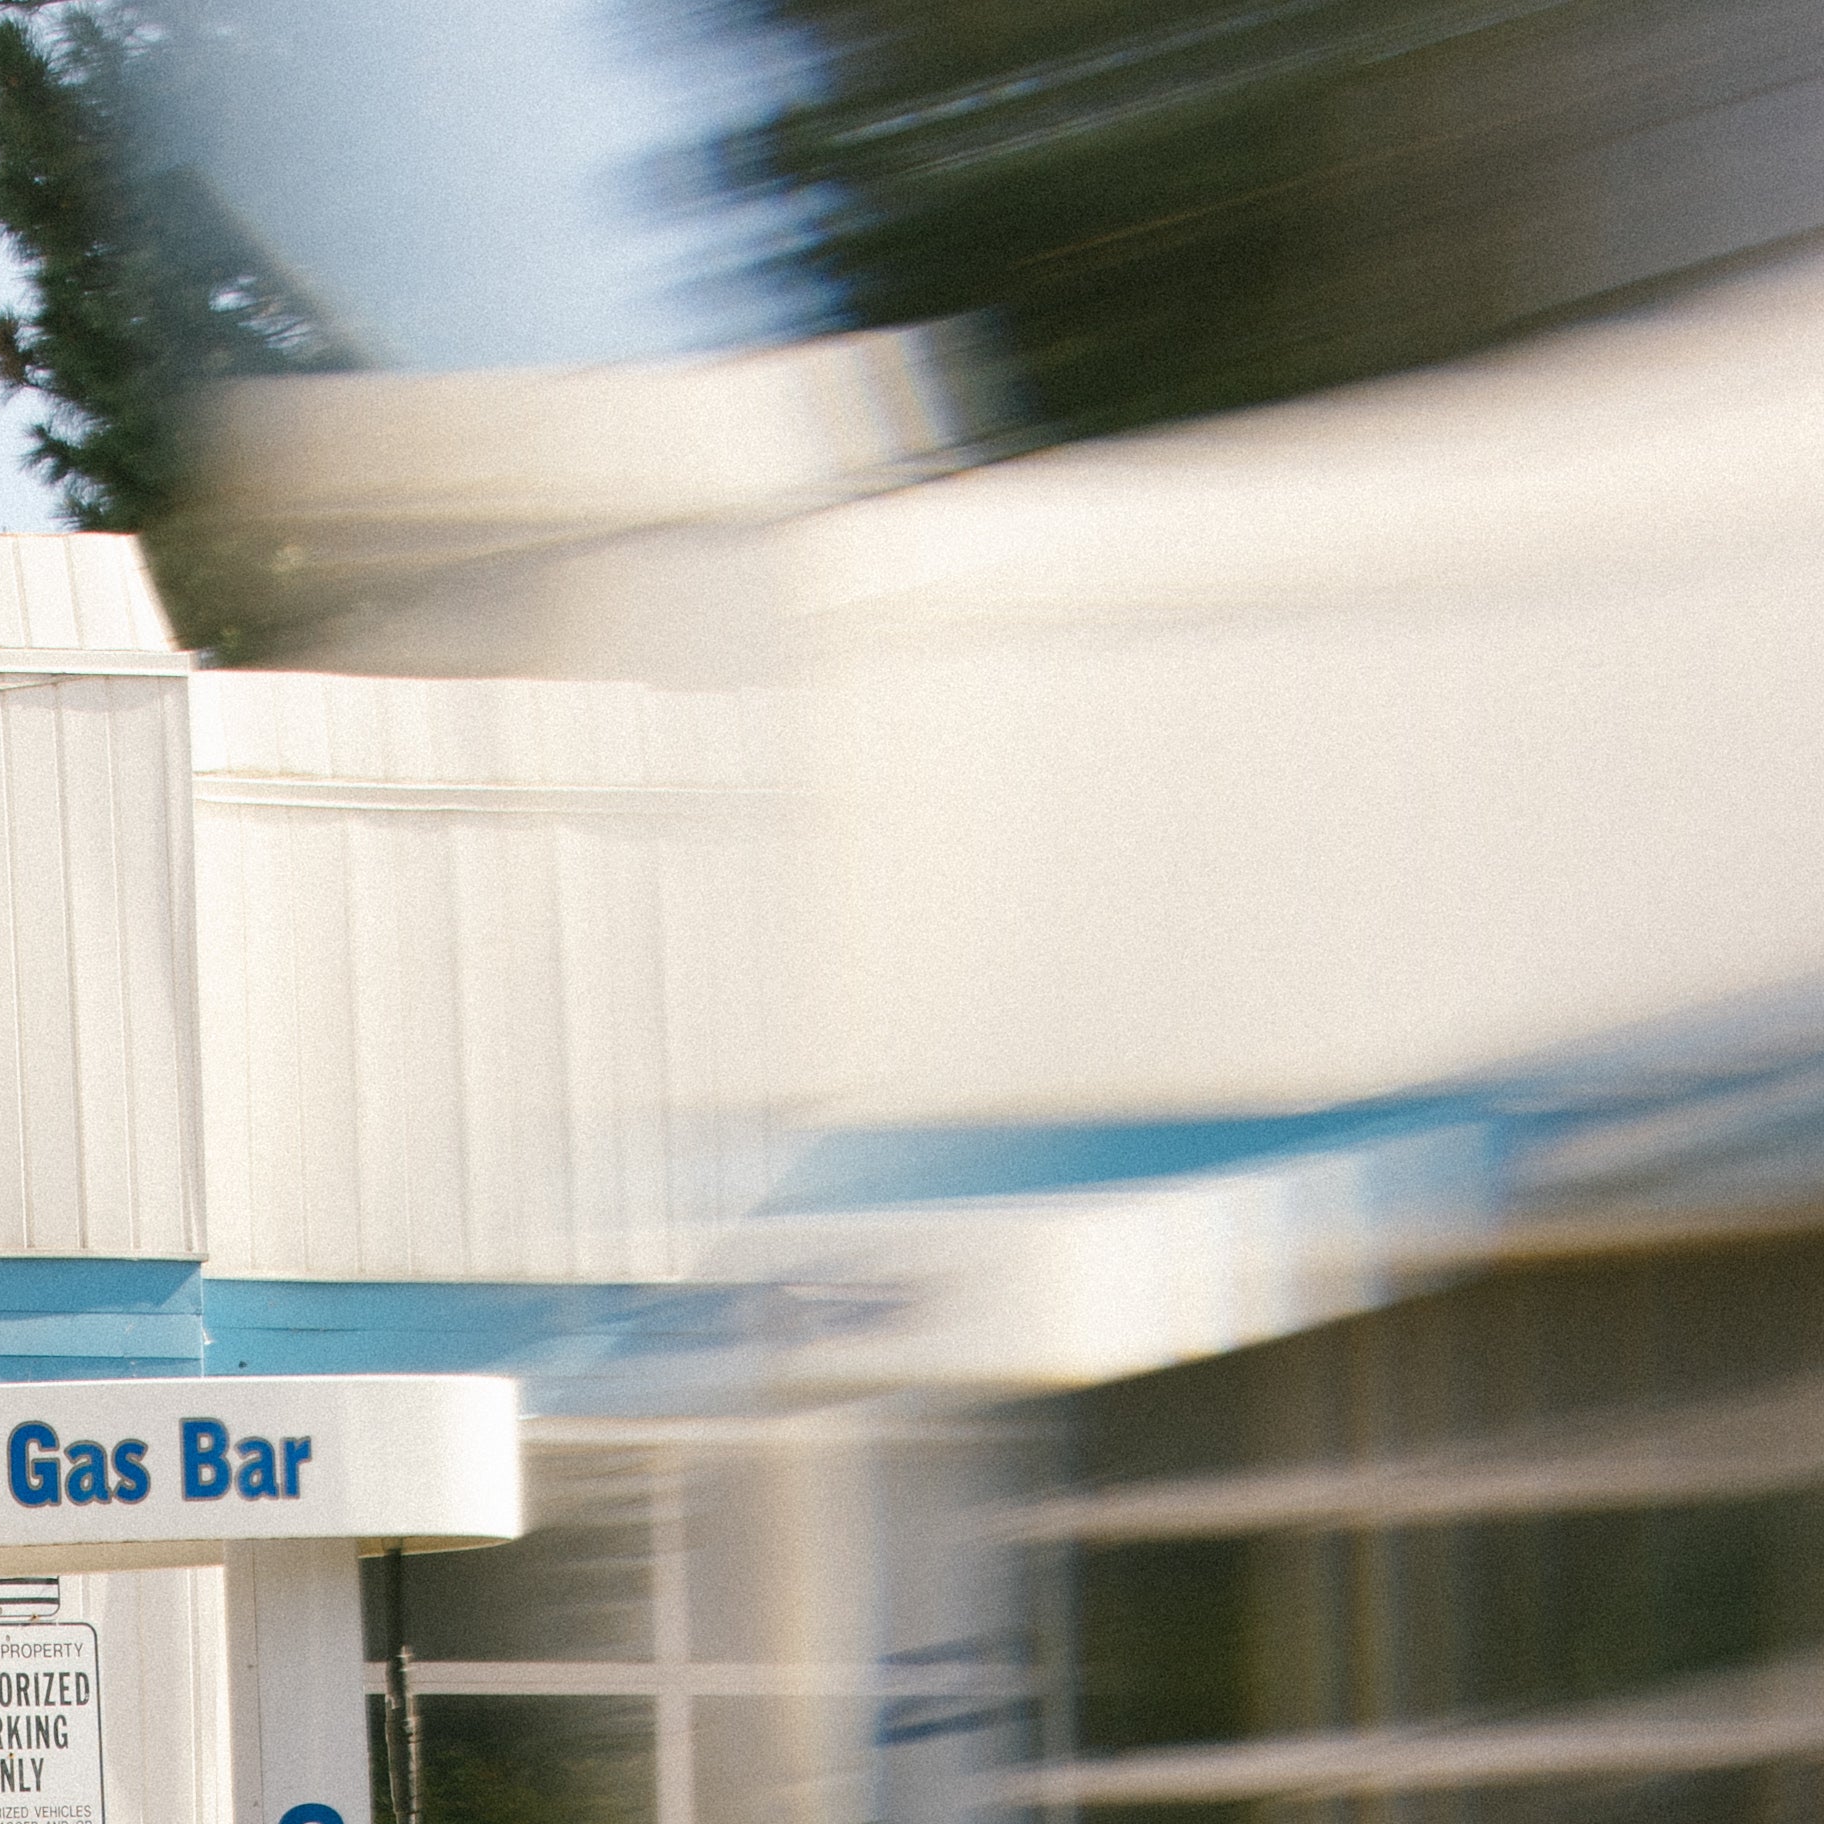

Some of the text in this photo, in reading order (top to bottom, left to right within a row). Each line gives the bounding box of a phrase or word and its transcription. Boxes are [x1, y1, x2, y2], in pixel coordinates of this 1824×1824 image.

[7, 1420, 151, 1508] Gas
[179, 1417, 312, 1502] Bar
[1, 1642, 84, 1658] PROPERTY
[34, 1805, 92, 1818] VEHICLES
